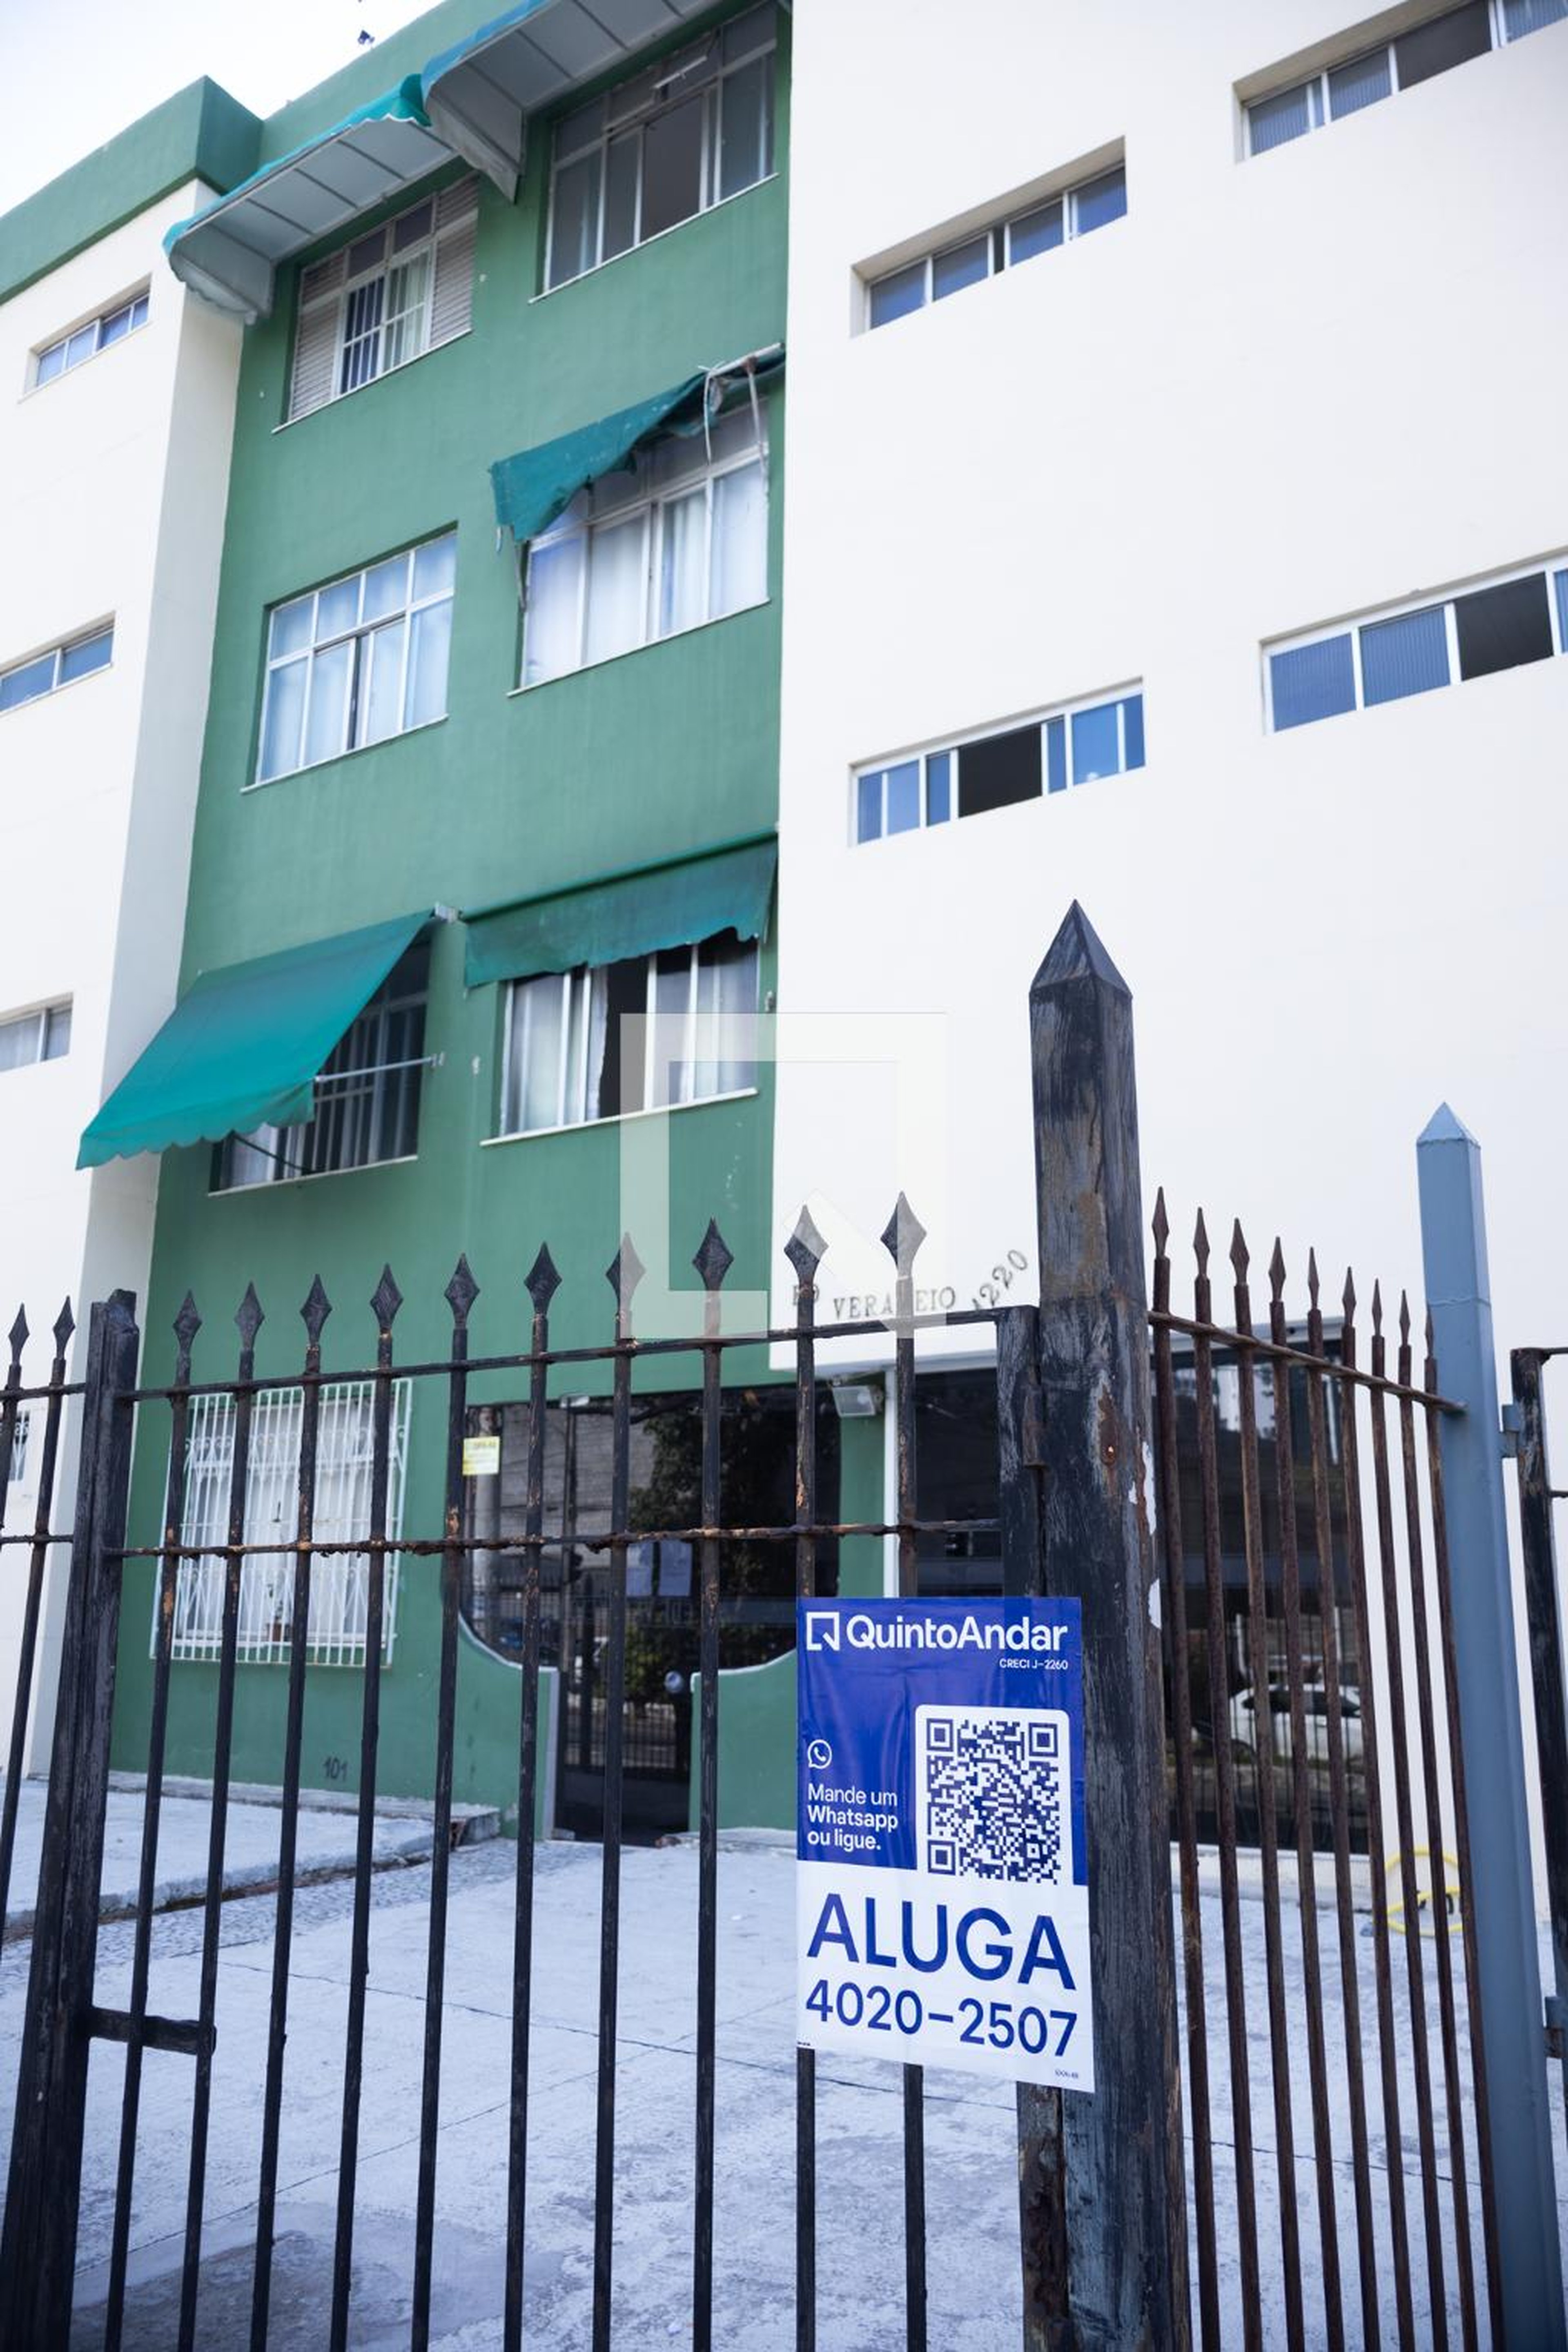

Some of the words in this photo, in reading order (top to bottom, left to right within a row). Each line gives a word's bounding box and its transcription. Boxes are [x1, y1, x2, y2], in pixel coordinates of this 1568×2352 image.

[833, 1286, 956, 1320] VERAEIO
[846, 1615, 1068, 1650] QuintoAndar
[999, 1658, 1030, 1668] CRECI
[1031, 1659, 1068, 1670] J-2260
[323, 1757, 348, 1781] 101
[808, 1782, 866, 1805] Mande
[871, 1791, 898, 1806] um
[807, 1804, 898, 1833] Whatsapp
[807, 1830, 831, 1846] ou
[835, 1828, 881, 1852] ligue.
[807, 1893, 1076, 1991] ALUGA
[806, 1979, 1078, 2057] 4020-2507
